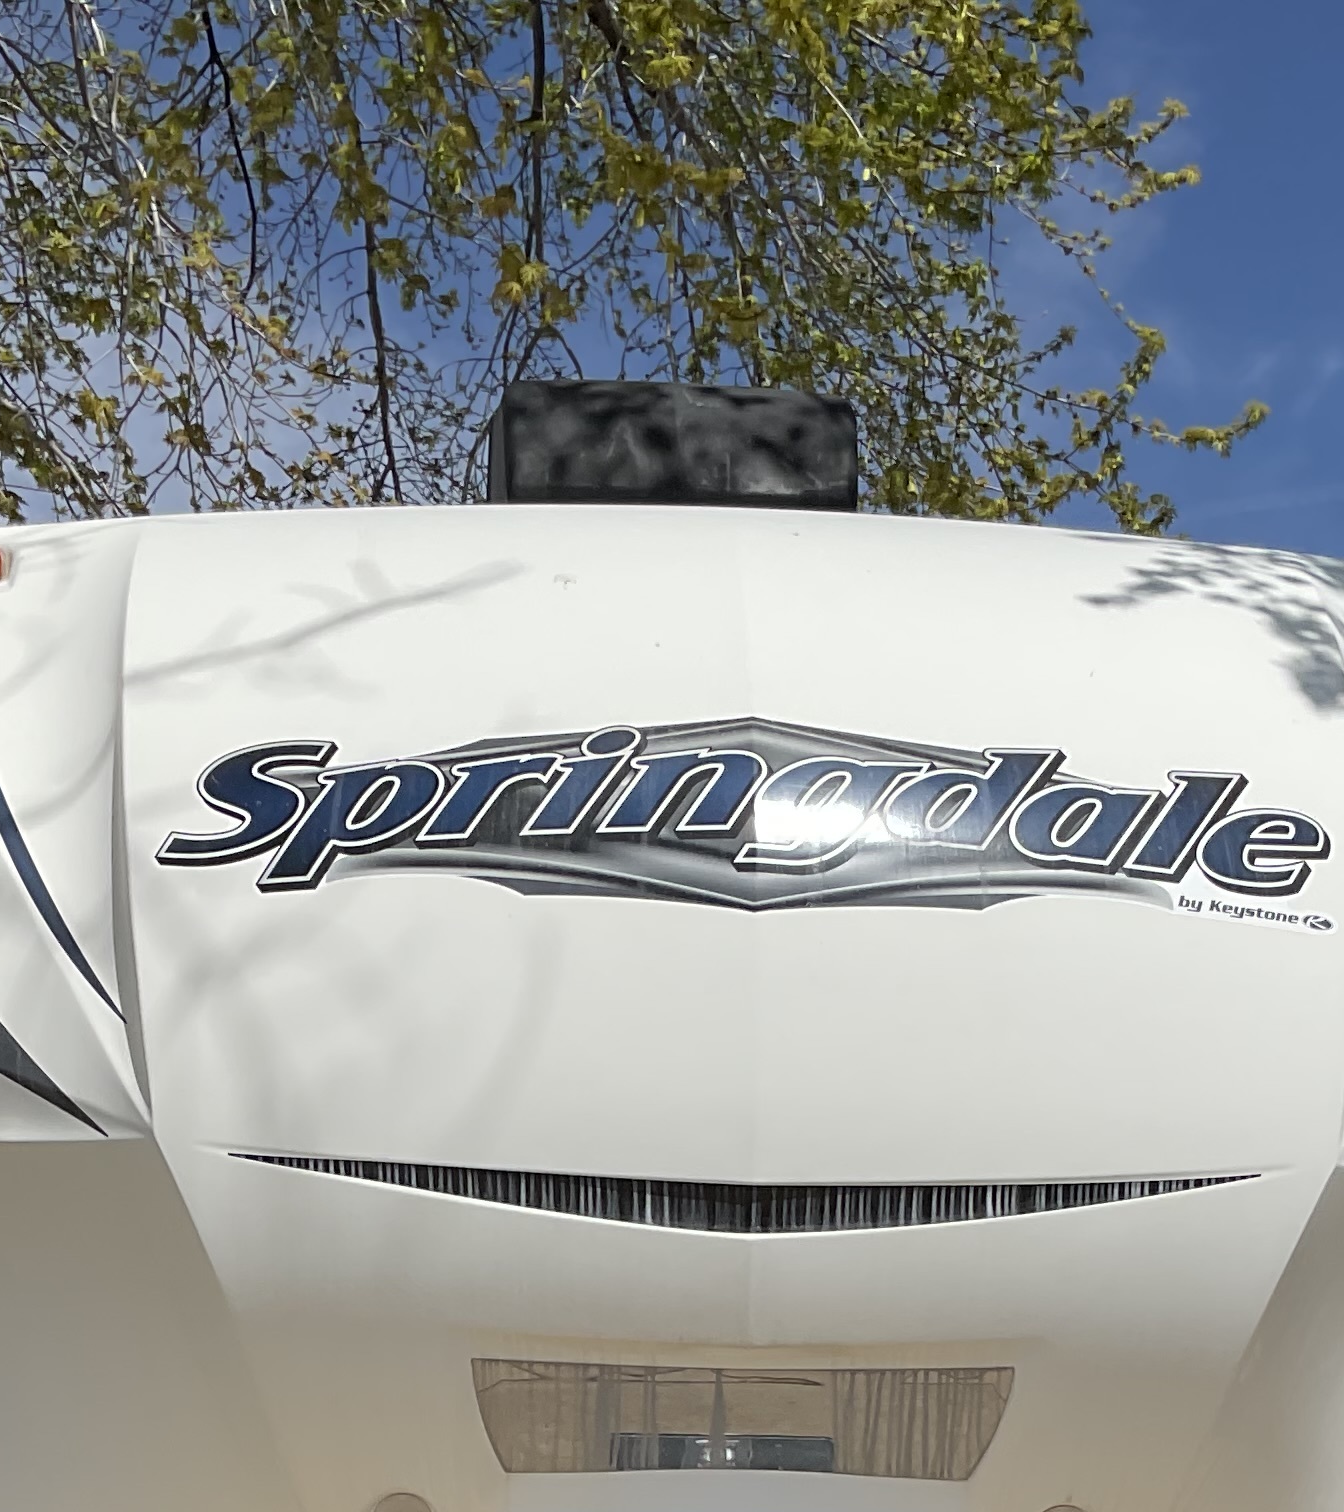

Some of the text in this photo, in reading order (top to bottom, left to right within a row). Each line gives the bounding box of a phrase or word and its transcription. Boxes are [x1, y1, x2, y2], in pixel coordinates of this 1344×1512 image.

[156, 725, 1331, 896] Springdale
[1177, 895, 1203, 913] by
[1209, 899, 1299, 925] Keystone
